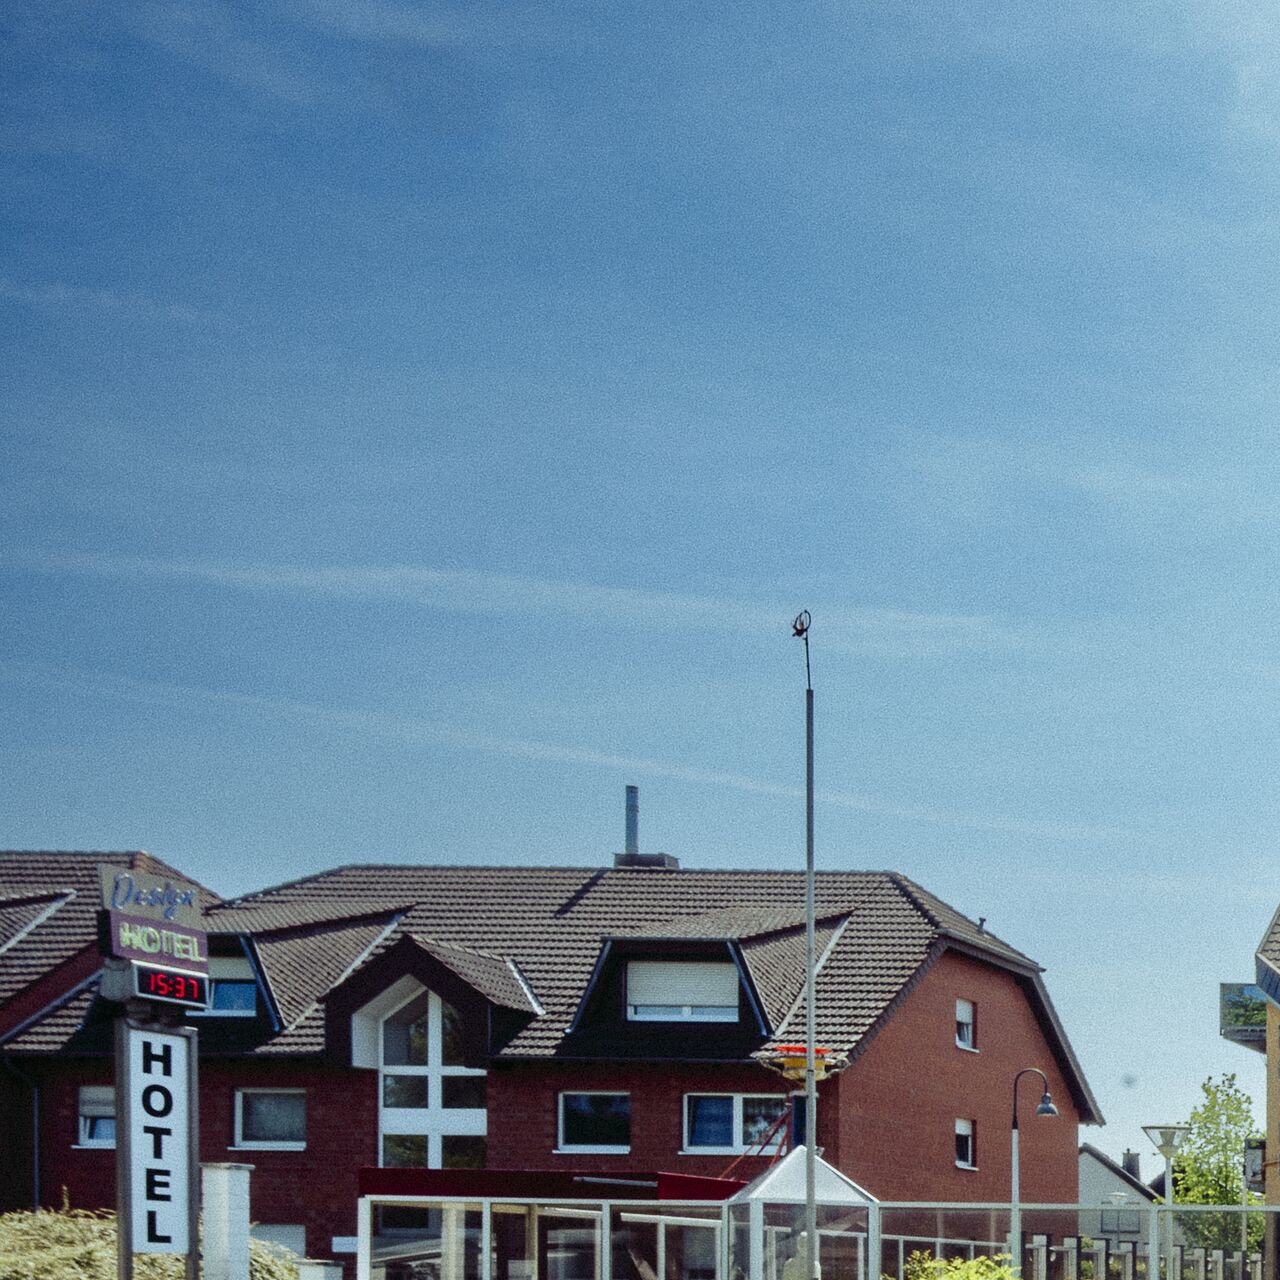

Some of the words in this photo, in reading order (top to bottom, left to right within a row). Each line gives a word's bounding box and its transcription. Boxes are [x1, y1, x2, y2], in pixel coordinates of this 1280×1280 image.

[119, 922, 208, 962] HOTEL
[149, 973, 199, 1000] 15:37
[142, 1041, 173, 1244] HOTEL
